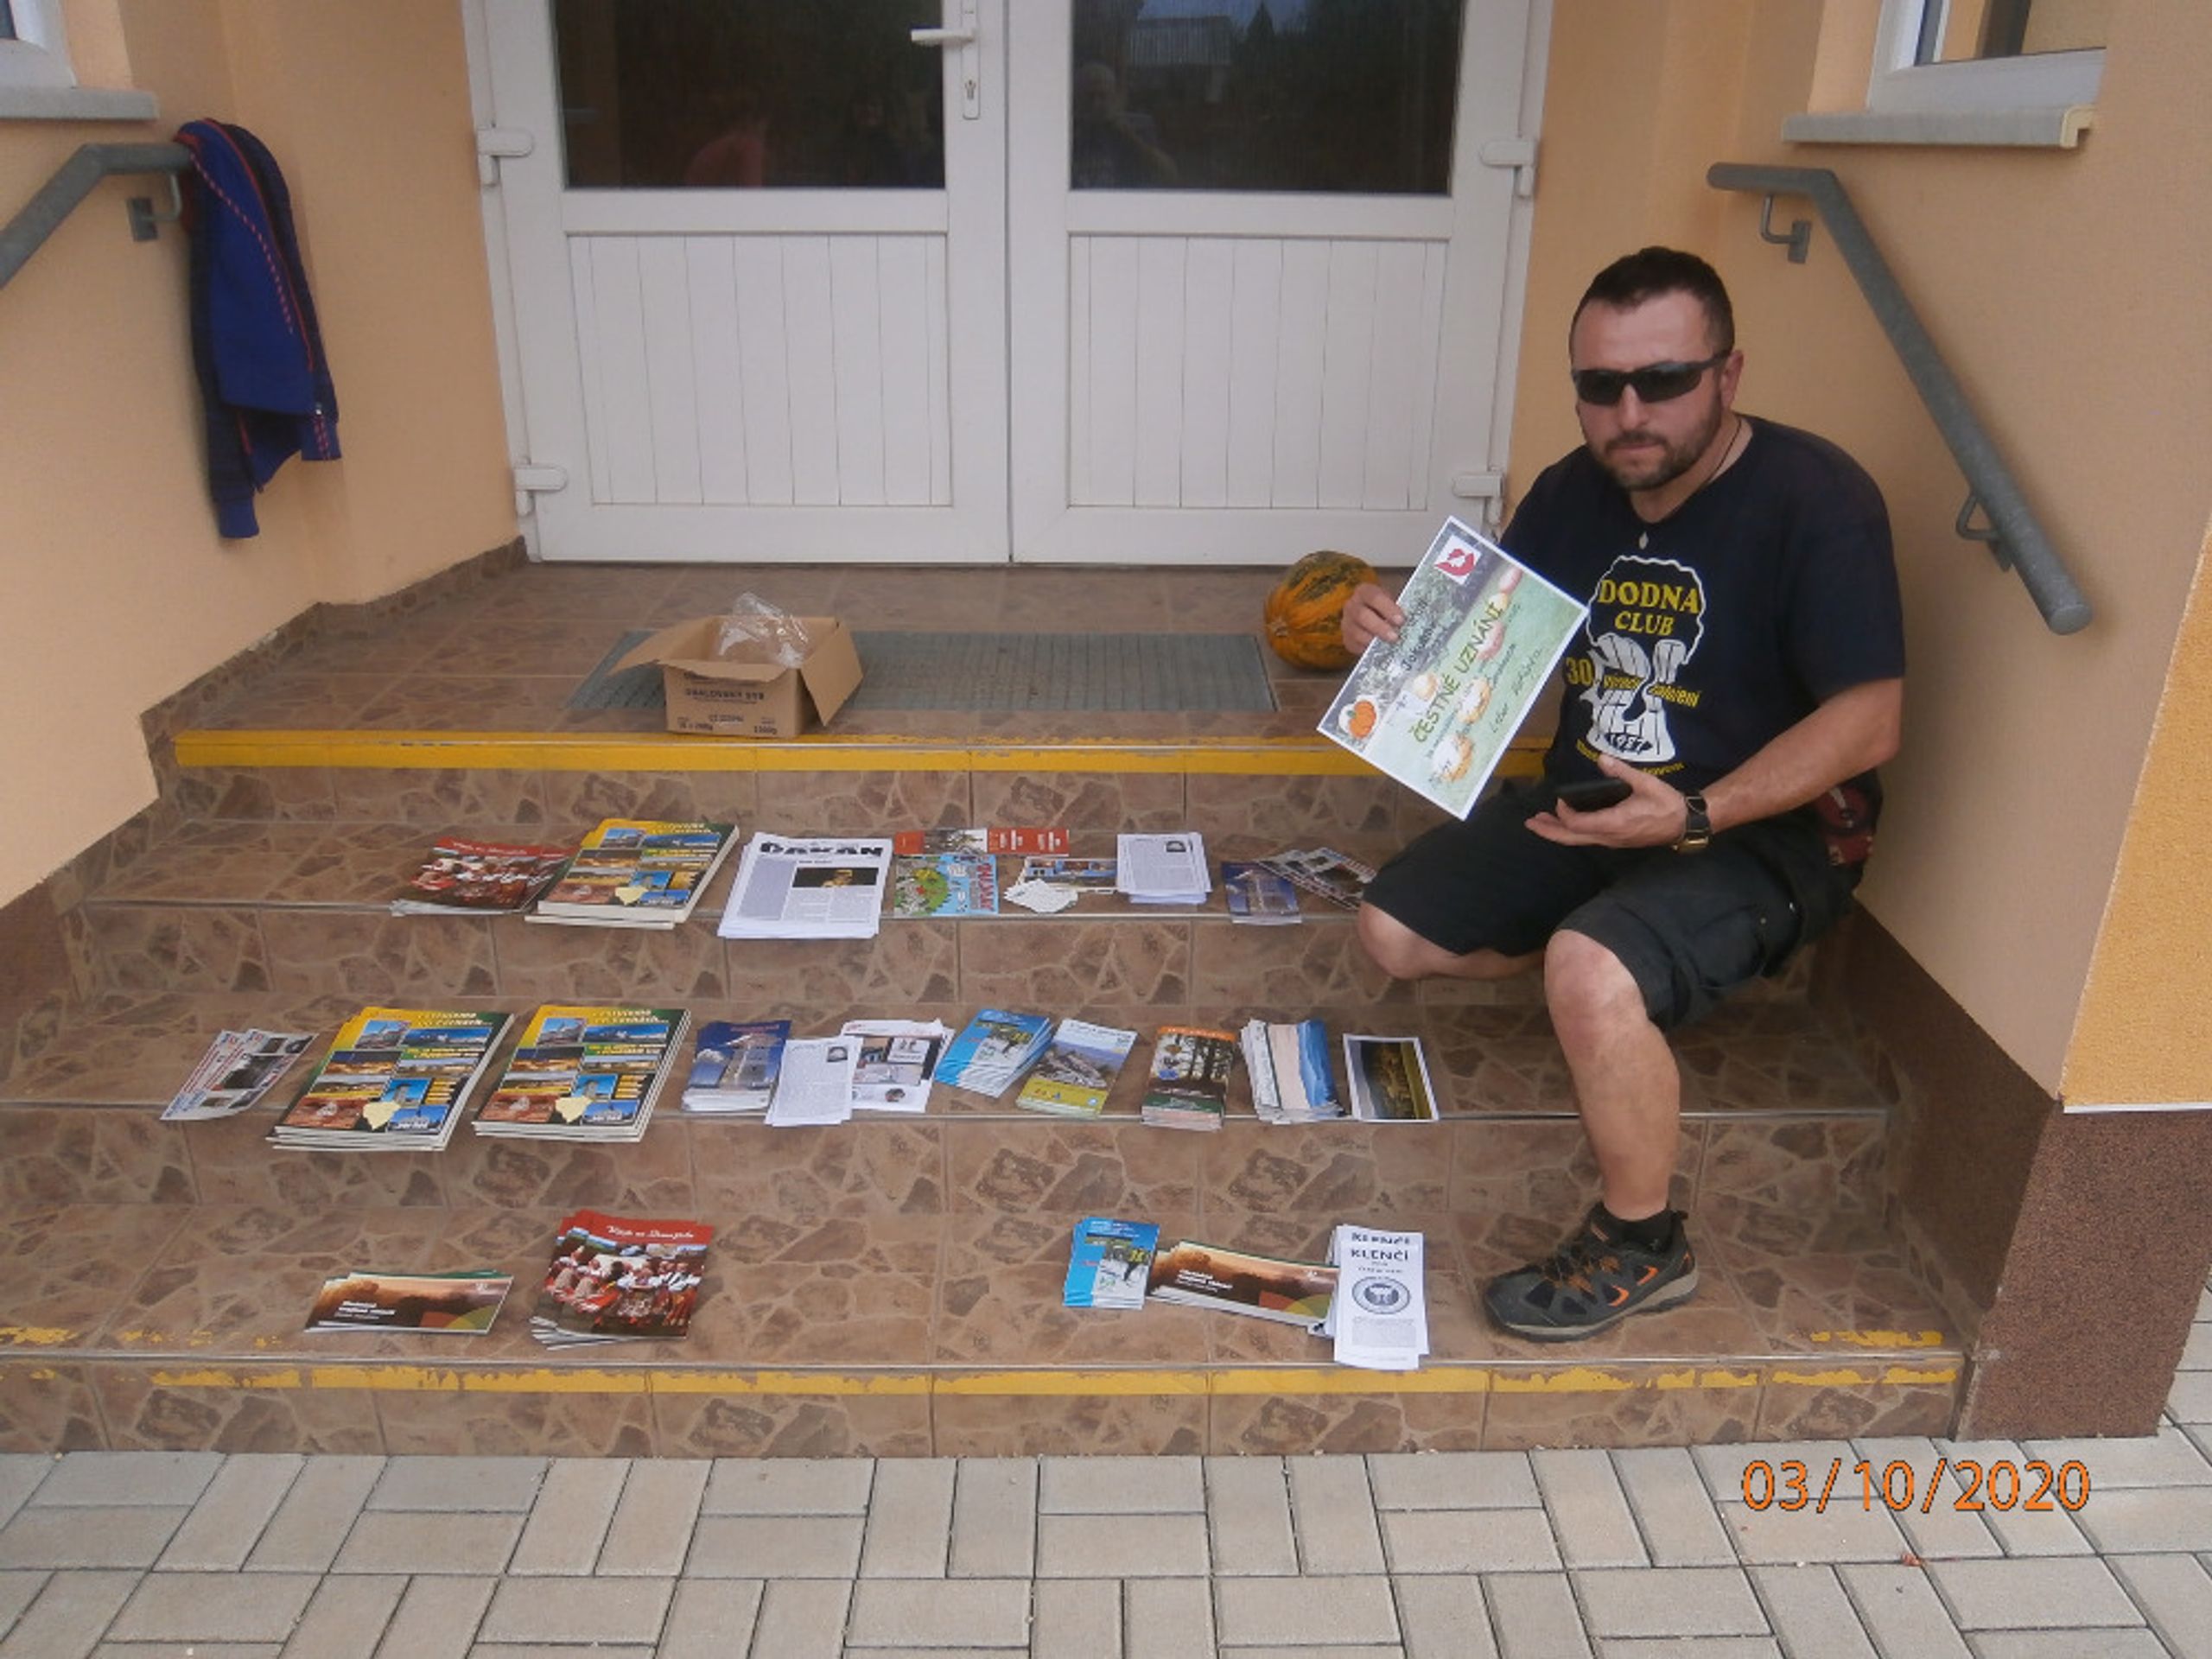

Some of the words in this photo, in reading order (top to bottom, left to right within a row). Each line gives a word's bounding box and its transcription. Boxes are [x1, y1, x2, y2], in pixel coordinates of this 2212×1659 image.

[1599, 580, 1700, 613] DODNA
[1614, 611, 1675, 636] CLUB
[1566, 657, 1594, 685] 30
[1408, 673, 1459, 743] ČESTNÉ
